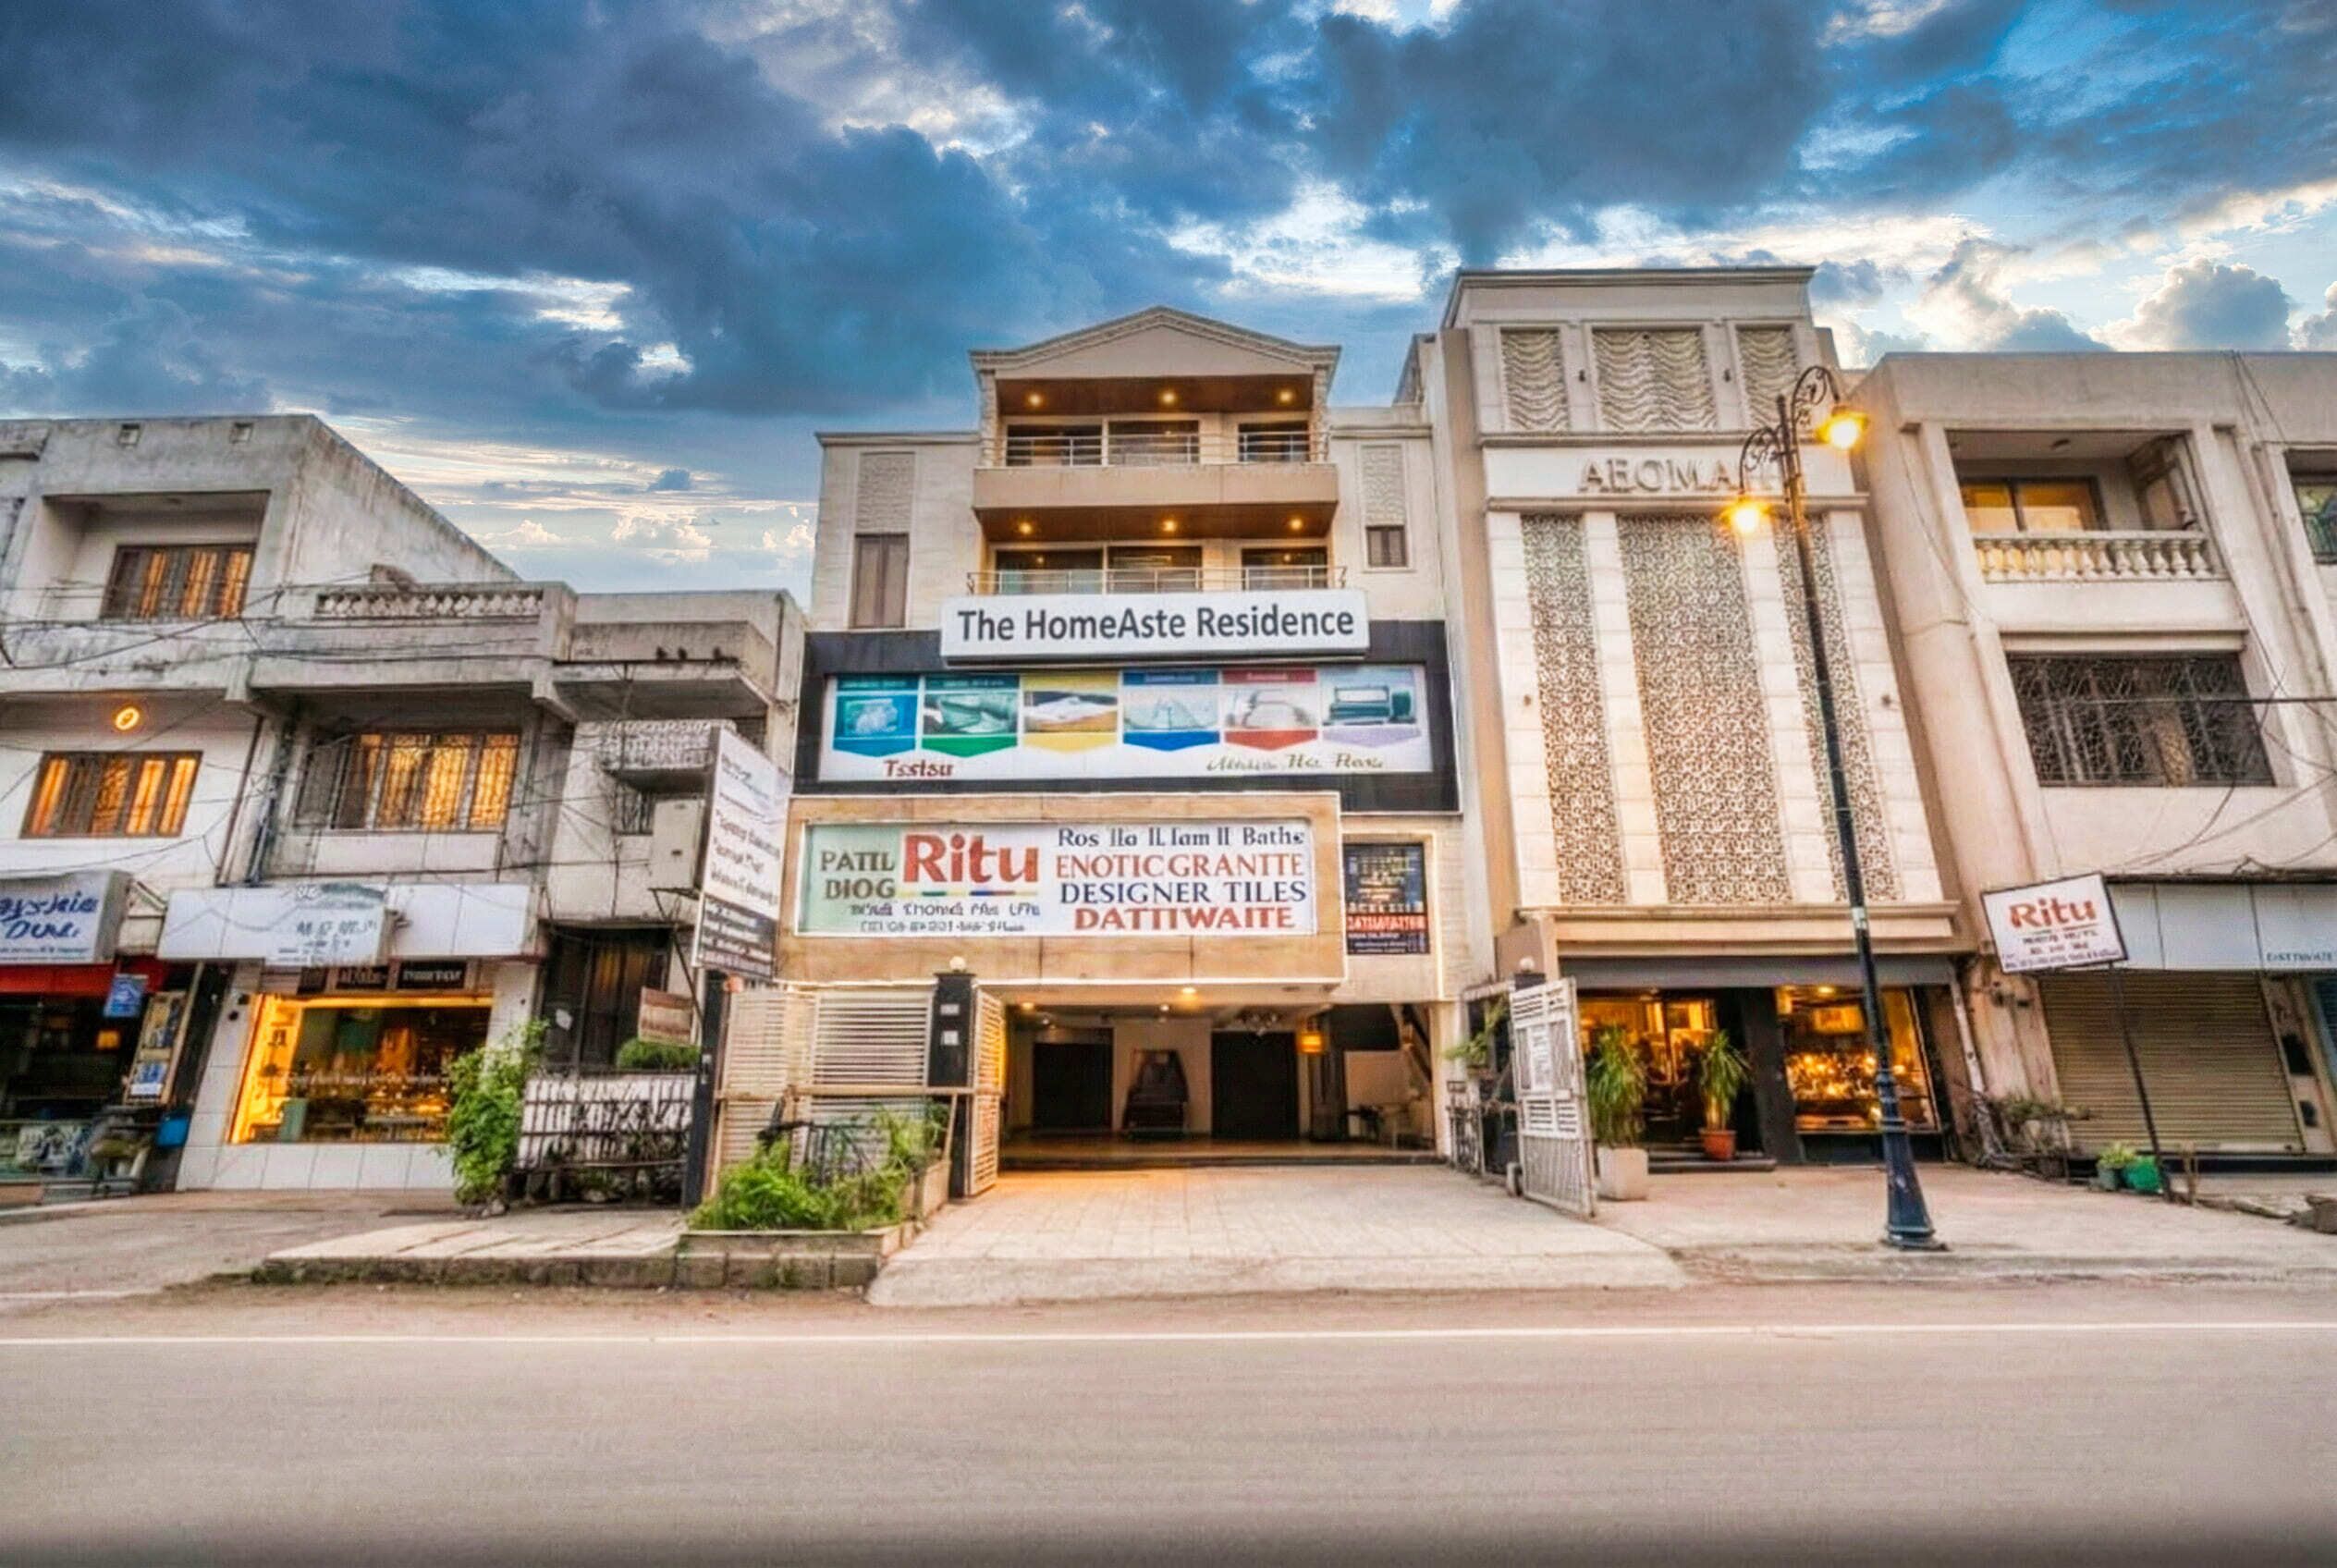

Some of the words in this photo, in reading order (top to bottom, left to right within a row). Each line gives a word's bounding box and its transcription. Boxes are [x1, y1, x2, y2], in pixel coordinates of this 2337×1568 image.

[957, 609, 1014, 641] The
[1024, 607, 1186, 640] HomeAste
[1196, 604, 1354, 637] Residence
[902, 833, 1039, 884] Ritu
[1060, 881, 1212, 905] DESIGNER
[1223, 881, 1307, 903] TILES
[2009, 898, 2098, 928] Ritu
